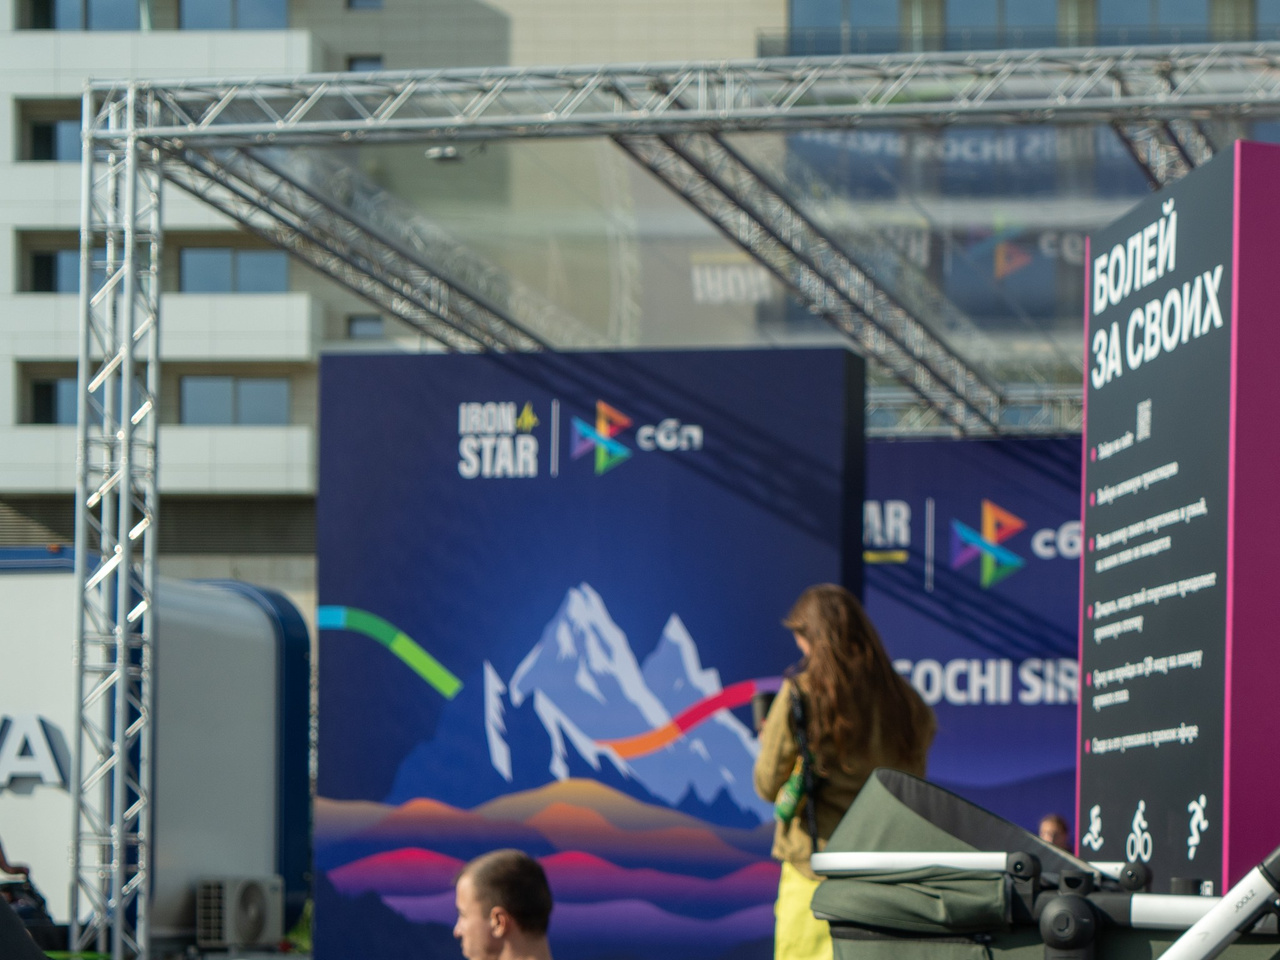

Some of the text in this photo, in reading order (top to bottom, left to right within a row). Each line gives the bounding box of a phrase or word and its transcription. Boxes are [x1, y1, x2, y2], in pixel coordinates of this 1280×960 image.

[1093, 197, 1177, 316] БОЛЕЙ
[1091, 264, 1224, 389] ЗА СВОИХ
[458, 402, 517, 435] IRON
[458, 434, 539, 479] STAR
[1233, 888, 1257, 913] JOOLZ
